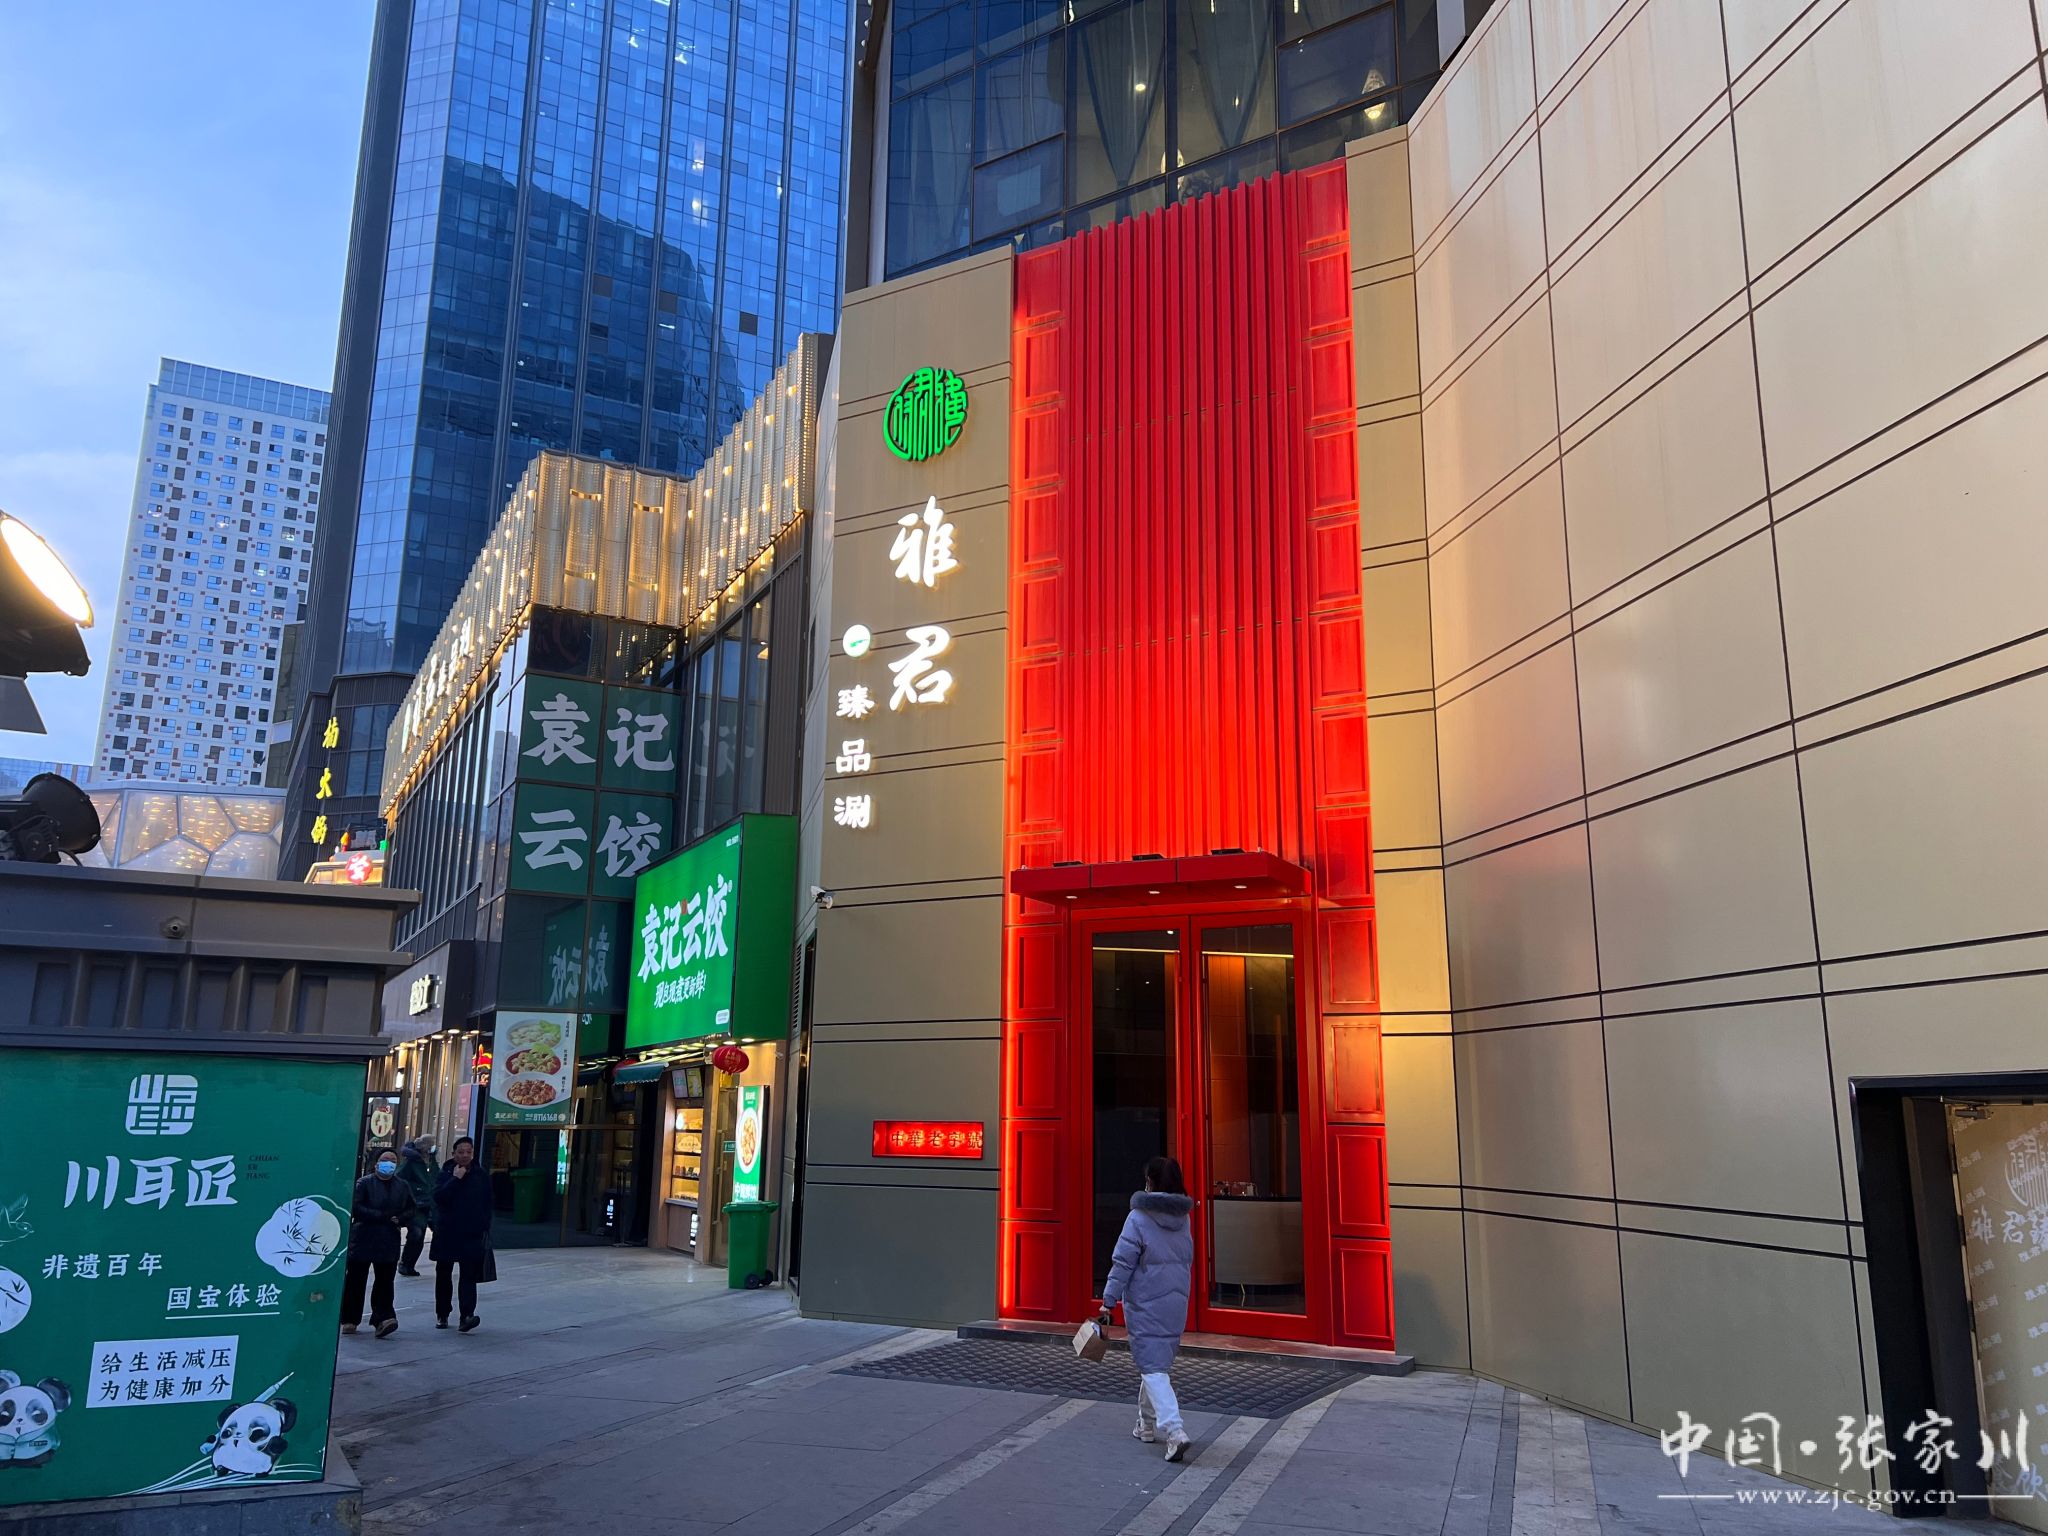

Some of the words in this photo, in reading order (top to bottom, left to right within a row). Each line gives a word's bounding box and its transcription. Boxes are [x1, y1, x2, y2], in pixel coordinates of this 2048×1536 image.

[888, 496, 958, 711] 雅君
[522, 692, 676, 772] 袁记
[834, 684, 873, 829] 臻品涮
[518, 808, 662, 878] 云饺
[637, 873, 729, 983] 袁记云饺
[64, 1155, 238, 1210] 川耳匠
[42, 1252, 163, 1280] 非遗百年
[167, 1283, 282, 1311] 国宝体验
[100, 1347, 232, 1375] 给生活减压
[100, 1374, 231, 1401] 为健康加分
